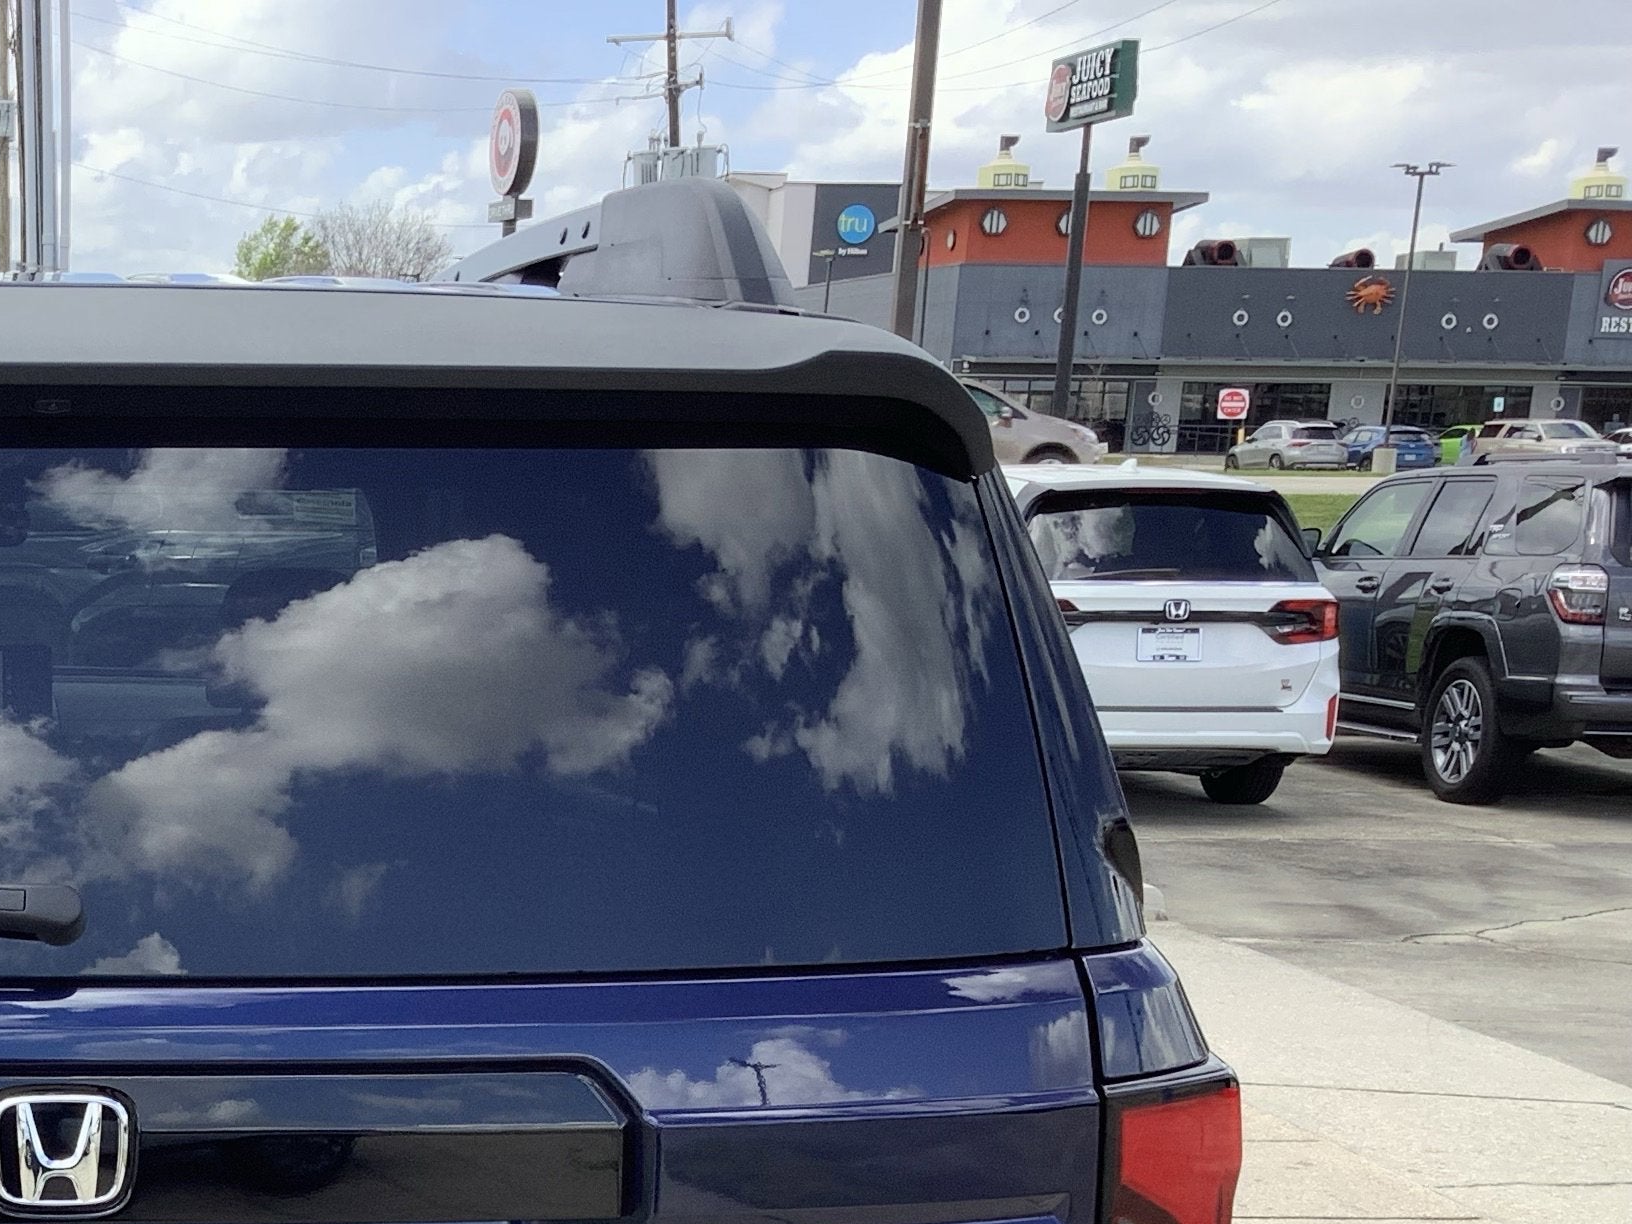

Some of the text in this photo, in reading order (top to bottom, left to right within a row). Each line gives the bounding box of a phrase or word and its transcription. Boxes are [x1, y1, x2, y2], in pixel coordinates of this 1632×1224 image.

[1072, 48, 1114, 84] JUICY
[1070, 77, 1110, 105] SEAFOOD
[840, 213, 868, 233] tru
